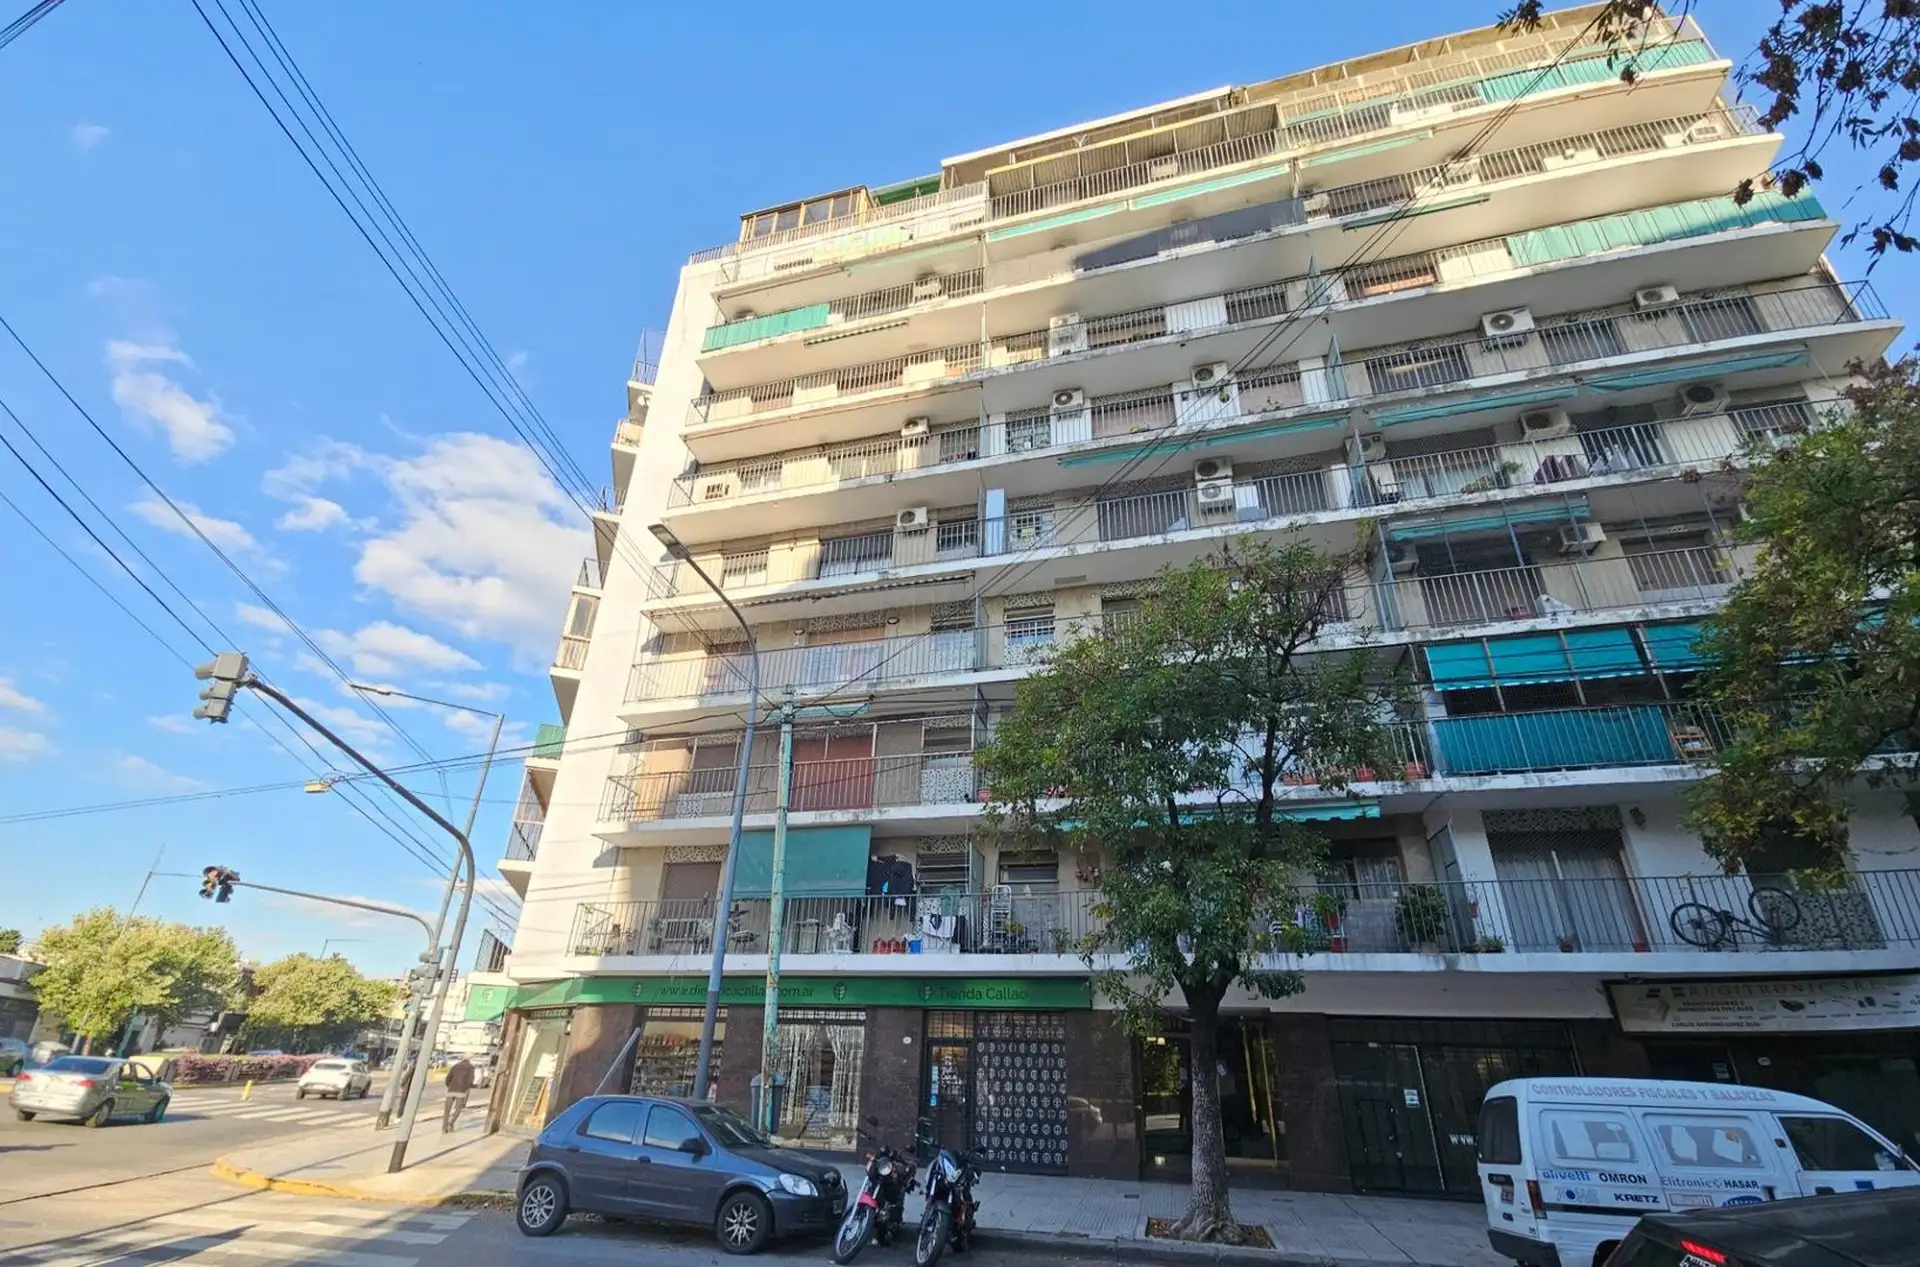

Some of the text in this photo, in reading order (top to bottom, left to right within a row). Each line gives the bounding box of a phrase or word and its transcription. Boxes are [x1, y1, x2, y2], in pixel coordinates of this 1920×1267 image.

[940, 986, 1028, 1001] Tienda Callao
[1531, 1083, 1637, 1098] CONTROLADORES
[1639, 1087, 1698, 1100] FISCALES
[1449, 1134, 1479, 1146] www.
[1542, 1169, 1592, 1182] olivetti
[1598, 1172, 1649, 1184] OMRON
[1723, 1179, 1760, 1190] HASAR
[1613, 1192, 1660, 1204] KRETZ
